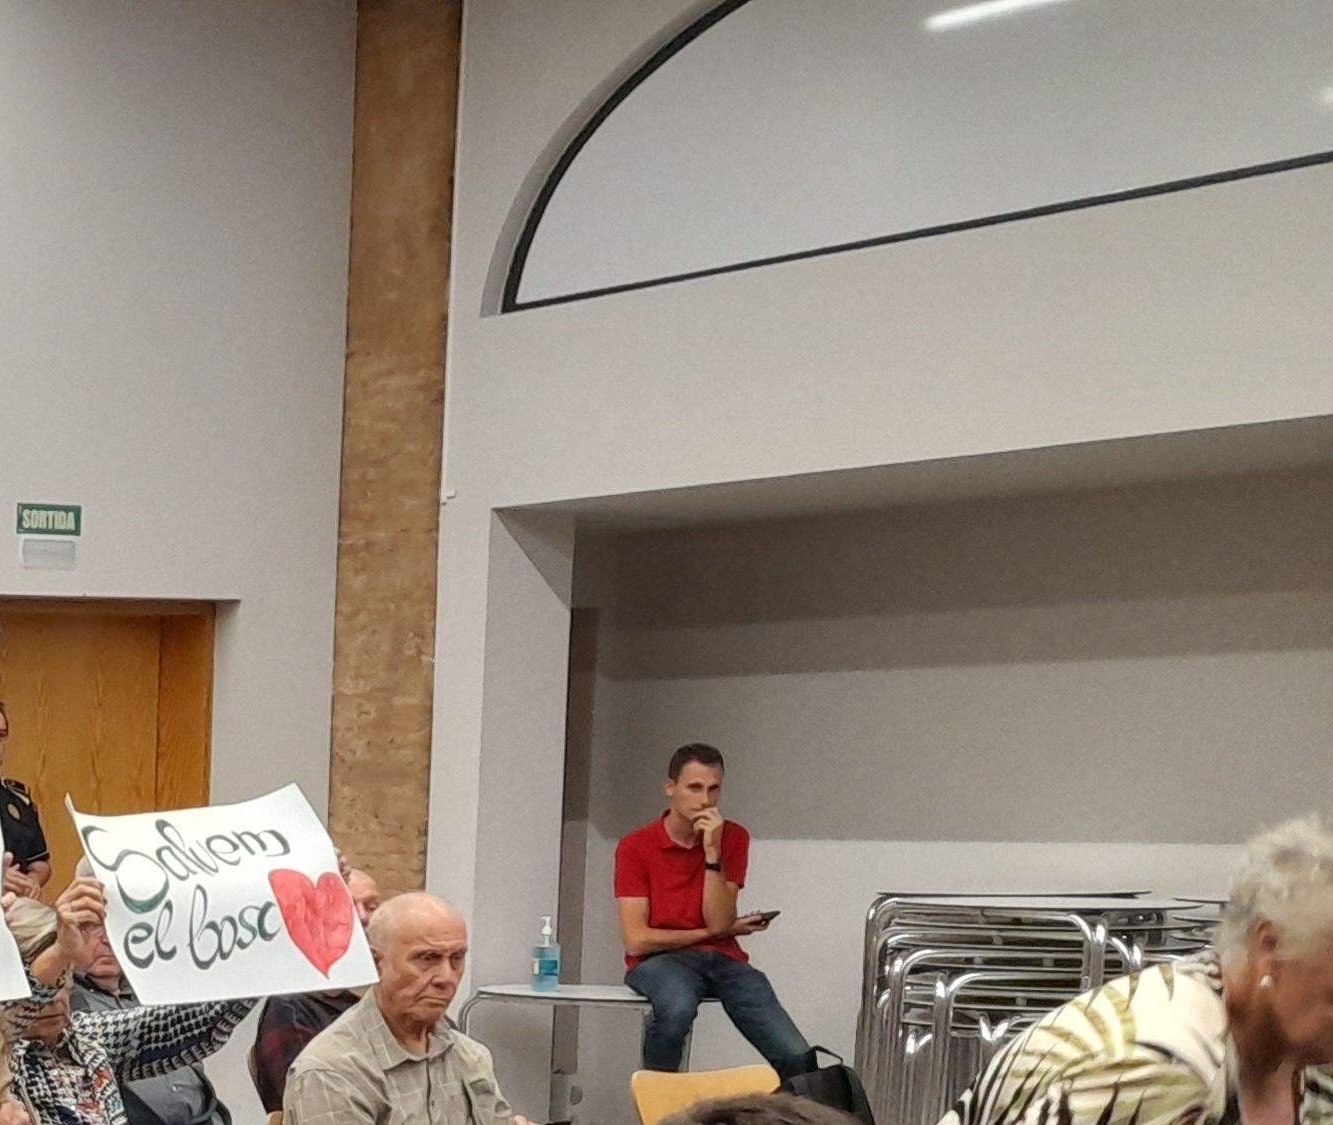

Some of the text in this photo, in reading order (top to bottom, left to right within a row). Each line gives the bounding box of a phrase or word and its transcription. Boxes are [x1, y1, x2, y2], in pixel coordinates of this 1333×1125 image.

[22, 508, 76, 531] SORTIDA
[81, 818, 291, 914] Salvem
[123, 884, 281, 970] el bosc
